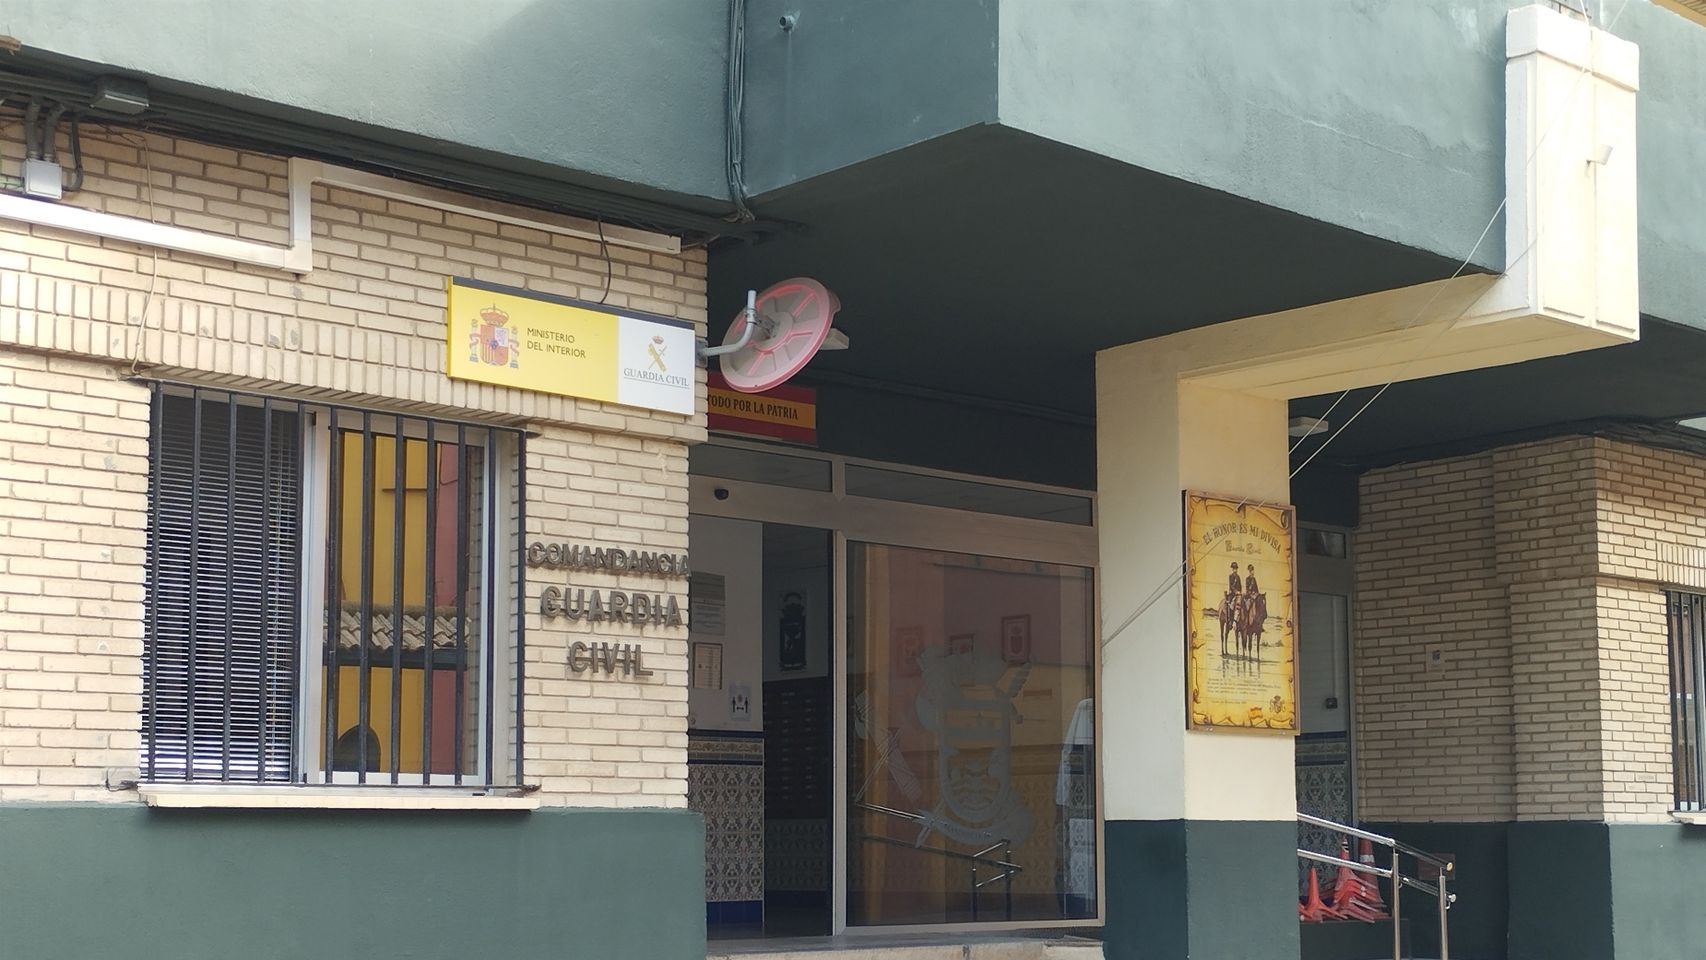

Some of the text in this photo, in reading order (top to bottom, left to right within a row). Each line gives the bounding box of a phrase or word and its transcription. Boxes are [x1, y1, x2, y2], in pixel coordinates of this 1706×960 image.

[527, 327, 575, 344] MINISTERIO
[527, 340, 586, 359] DEL INTERIOR
[623, 367, 689, 387] GUARDIA CIVIL
[733, 399, 752, 412] POR
[753, 402, 765, 414] LA
[767, 404, 798, 420] PATRIA
[1203, 532, 1213, 545] EL
[1239, 523, 1248, 533] ES
[1249, 525, 1259, 537] MI
[1260, 530, 1281, 554] DIVISA
[528, 541, 690, 576] COMANDANCIA
[541, 586, 683, 626] GUARDIA
[569, 641, 654, 677] CIVIL
